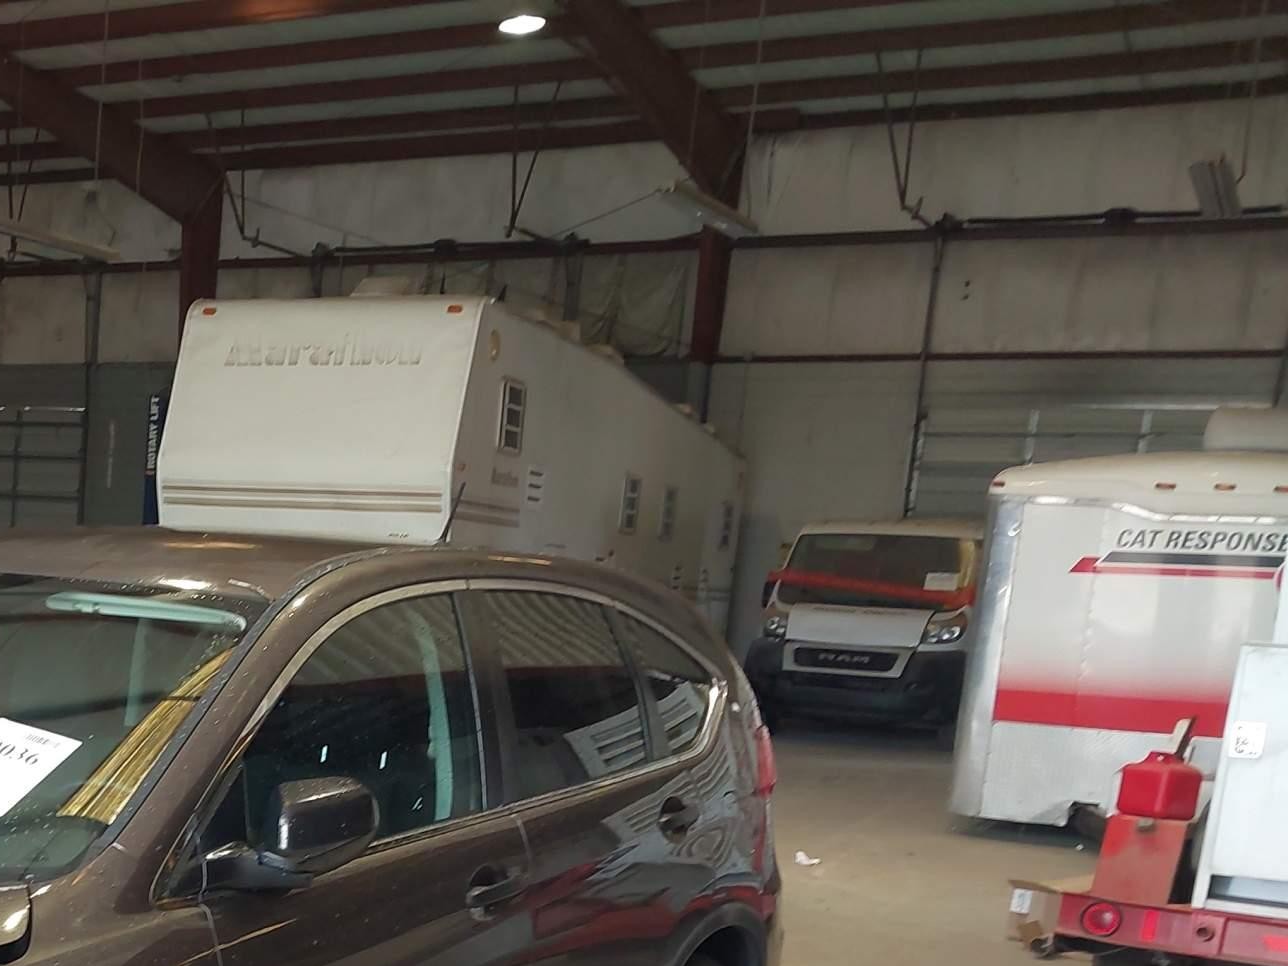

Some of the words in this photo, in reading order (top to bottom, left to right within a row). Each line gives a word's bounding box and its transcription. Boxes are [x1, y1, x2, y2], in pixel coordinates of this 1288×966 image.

[150, 396, 160, 420] LIFT
[147, 423, 158, 469] ROTARY
[1116, 528, 1163, 548] CAT
[818, 652, 870, 664] RAM
